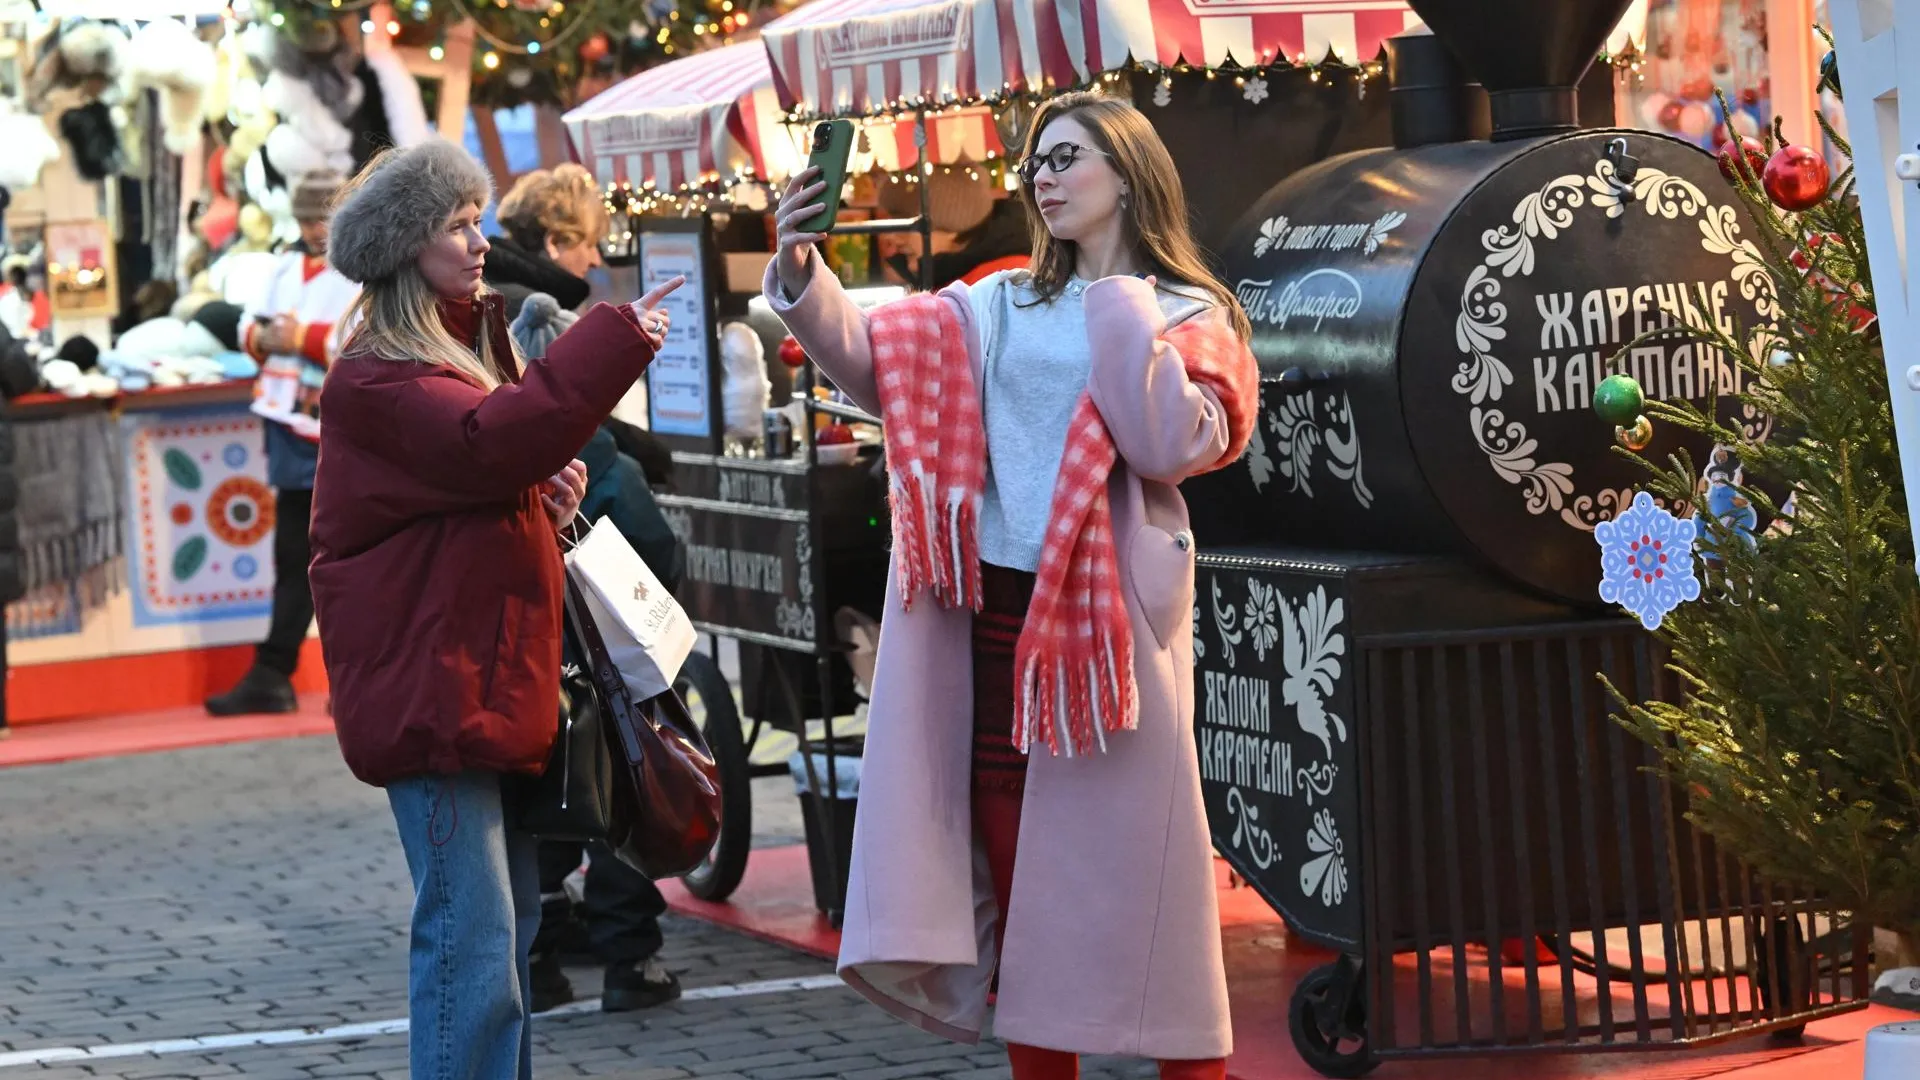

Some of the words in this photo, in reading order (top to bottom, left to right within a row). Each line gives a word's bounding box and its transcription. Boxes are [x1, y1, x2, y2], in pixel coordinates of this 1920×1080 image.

[1535, 280, 1732, 350] ЖАРЕНЫЕ
[1204, 670, 1270, 733] ЯБЛОКИ
[1201, 727, 1293, 797] КАРАМЕЛИ
